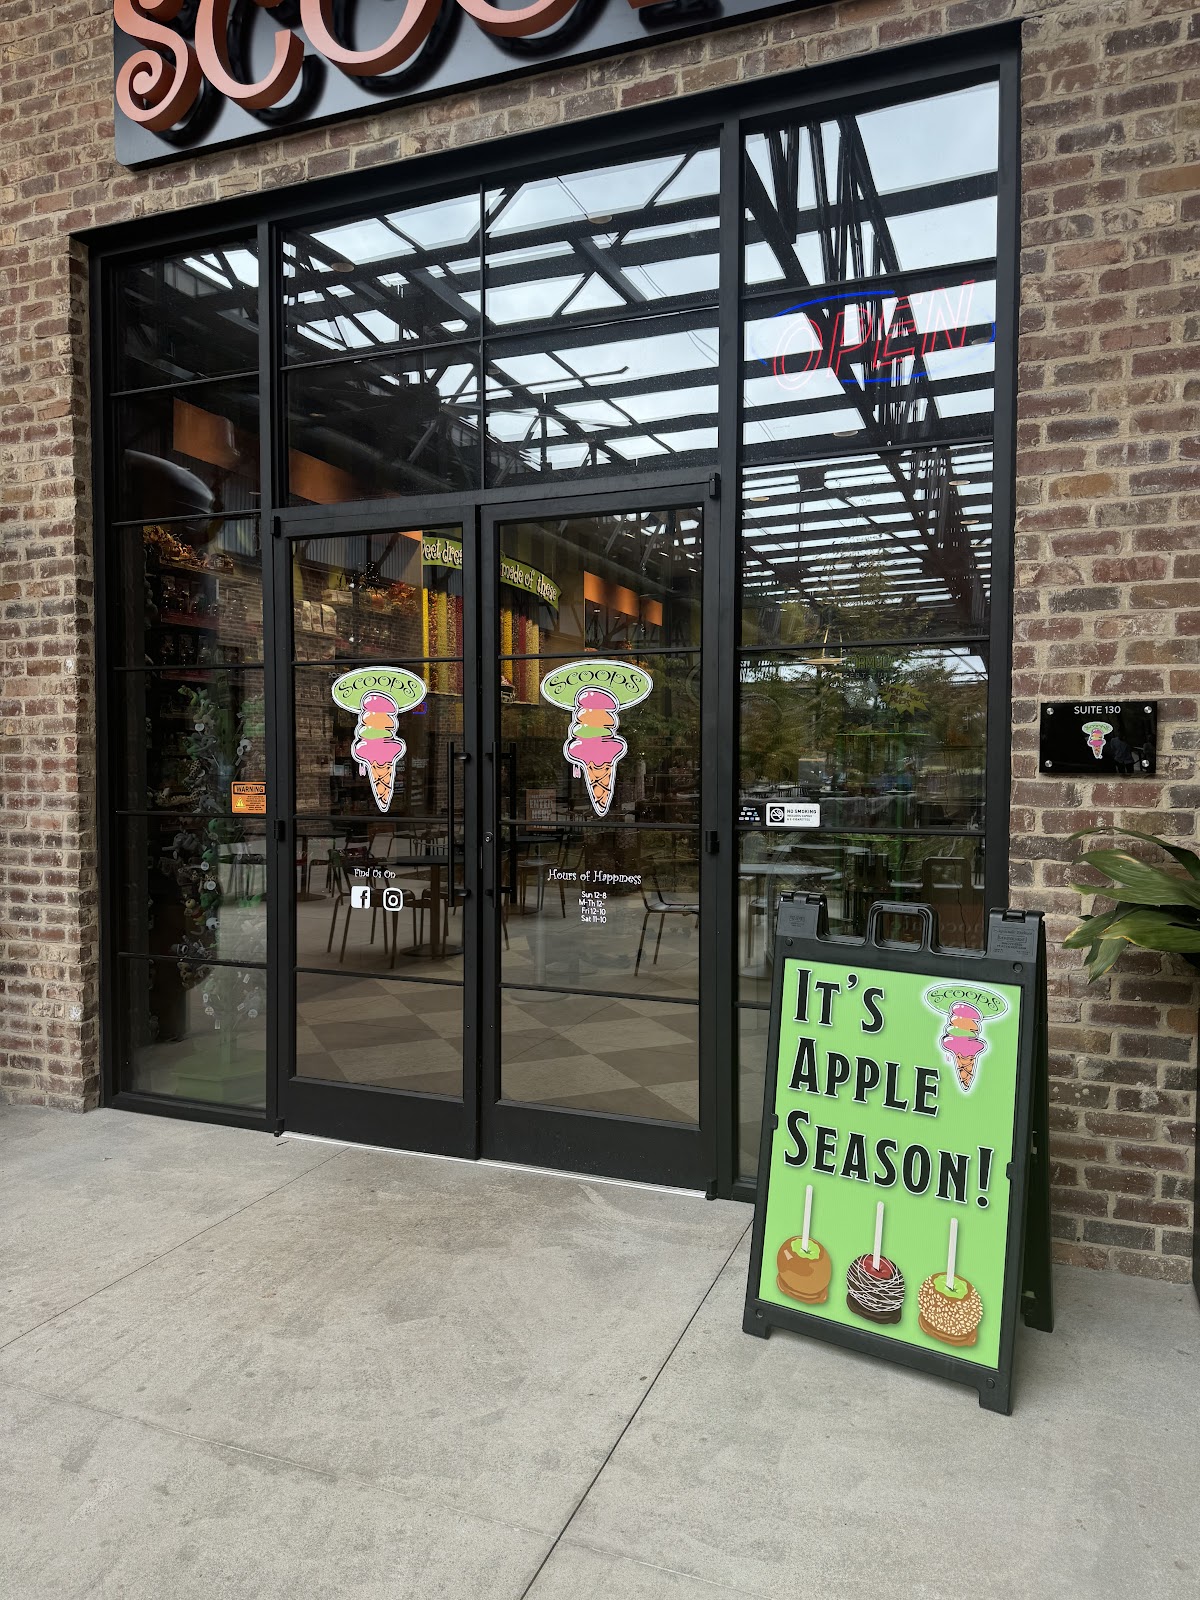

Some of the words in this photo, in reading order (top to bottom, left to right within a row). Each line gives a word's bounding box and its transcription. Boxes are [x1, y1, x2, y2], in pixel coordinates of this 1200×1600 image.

[774, 280, 976, 390] OPEN
[500, 562, 524, 584] made
[524, 570, 535, 588] of
[536, 575, 557, 601] these
[1074, 705, 1102, 714] SUITE
[1104, 705, 1121, 714] 130
[354, 867, 370, 877] Find
[372, 869, 382, 878] Us
[383, 870, 396, 878] On
[547, 869, 577, 881] Hours
[579, 870, 591, 881] of
[593, 870, 642, 885] Happiness
[581, 890, 593, 899] Sun
[594, 891, 607, 899] 12-8
[578, 898, 595, 907] M-Th
[581, 907, 590, 915] Fri
[590, 907, 607, 915] 12-10
[581, 915, 592, 923] Sat
[592, 915, 607, 924] 11-10
[793, 968, 885, 1034] IT'S
[788, 1036, 940, 1118] APPLE
[783, 1109, 994, 1209] SEASON!
